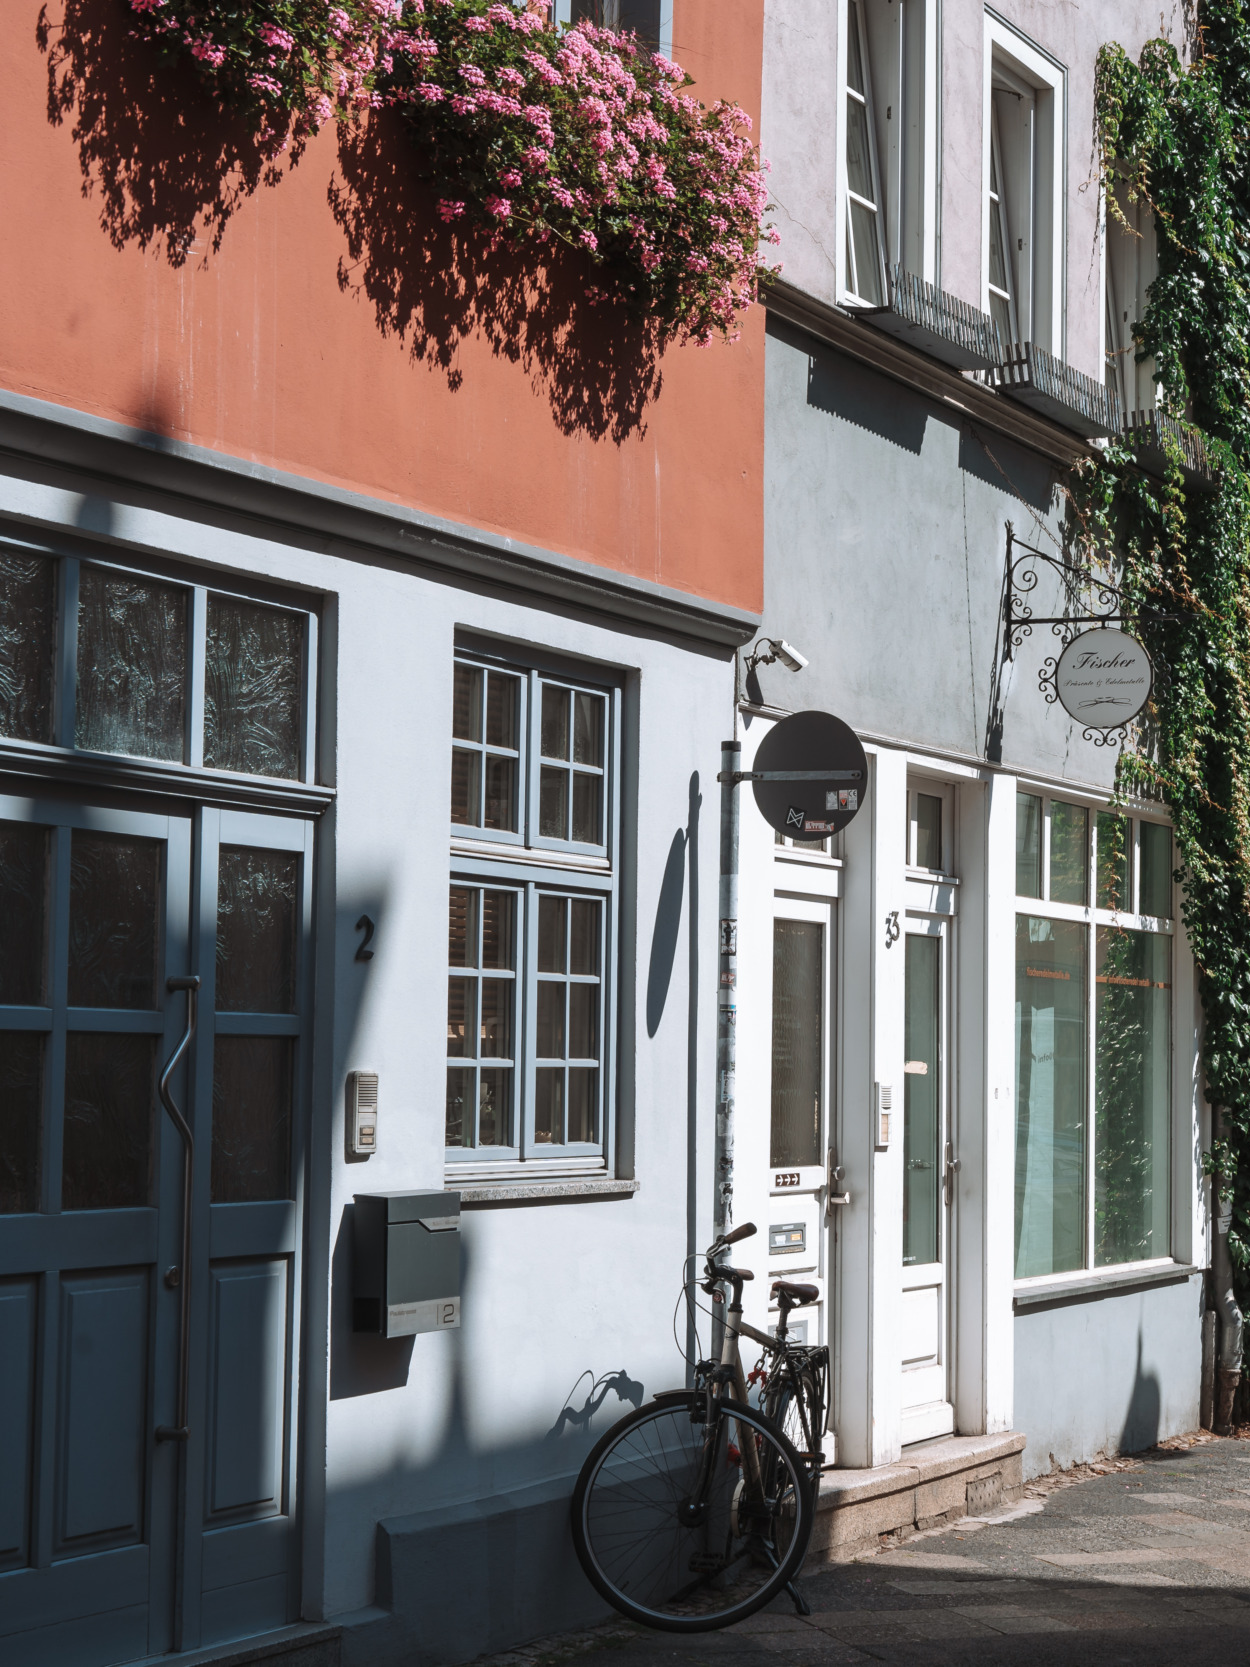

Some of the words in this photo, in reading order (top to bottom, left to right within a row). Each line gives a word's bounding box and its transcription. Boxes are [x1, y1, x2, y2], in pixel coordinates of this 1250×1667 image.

[1072, 651, 1136, 670] Fischer
[354, 913, 375, 964] 2
[443, 1303, 455, 1324] 2
